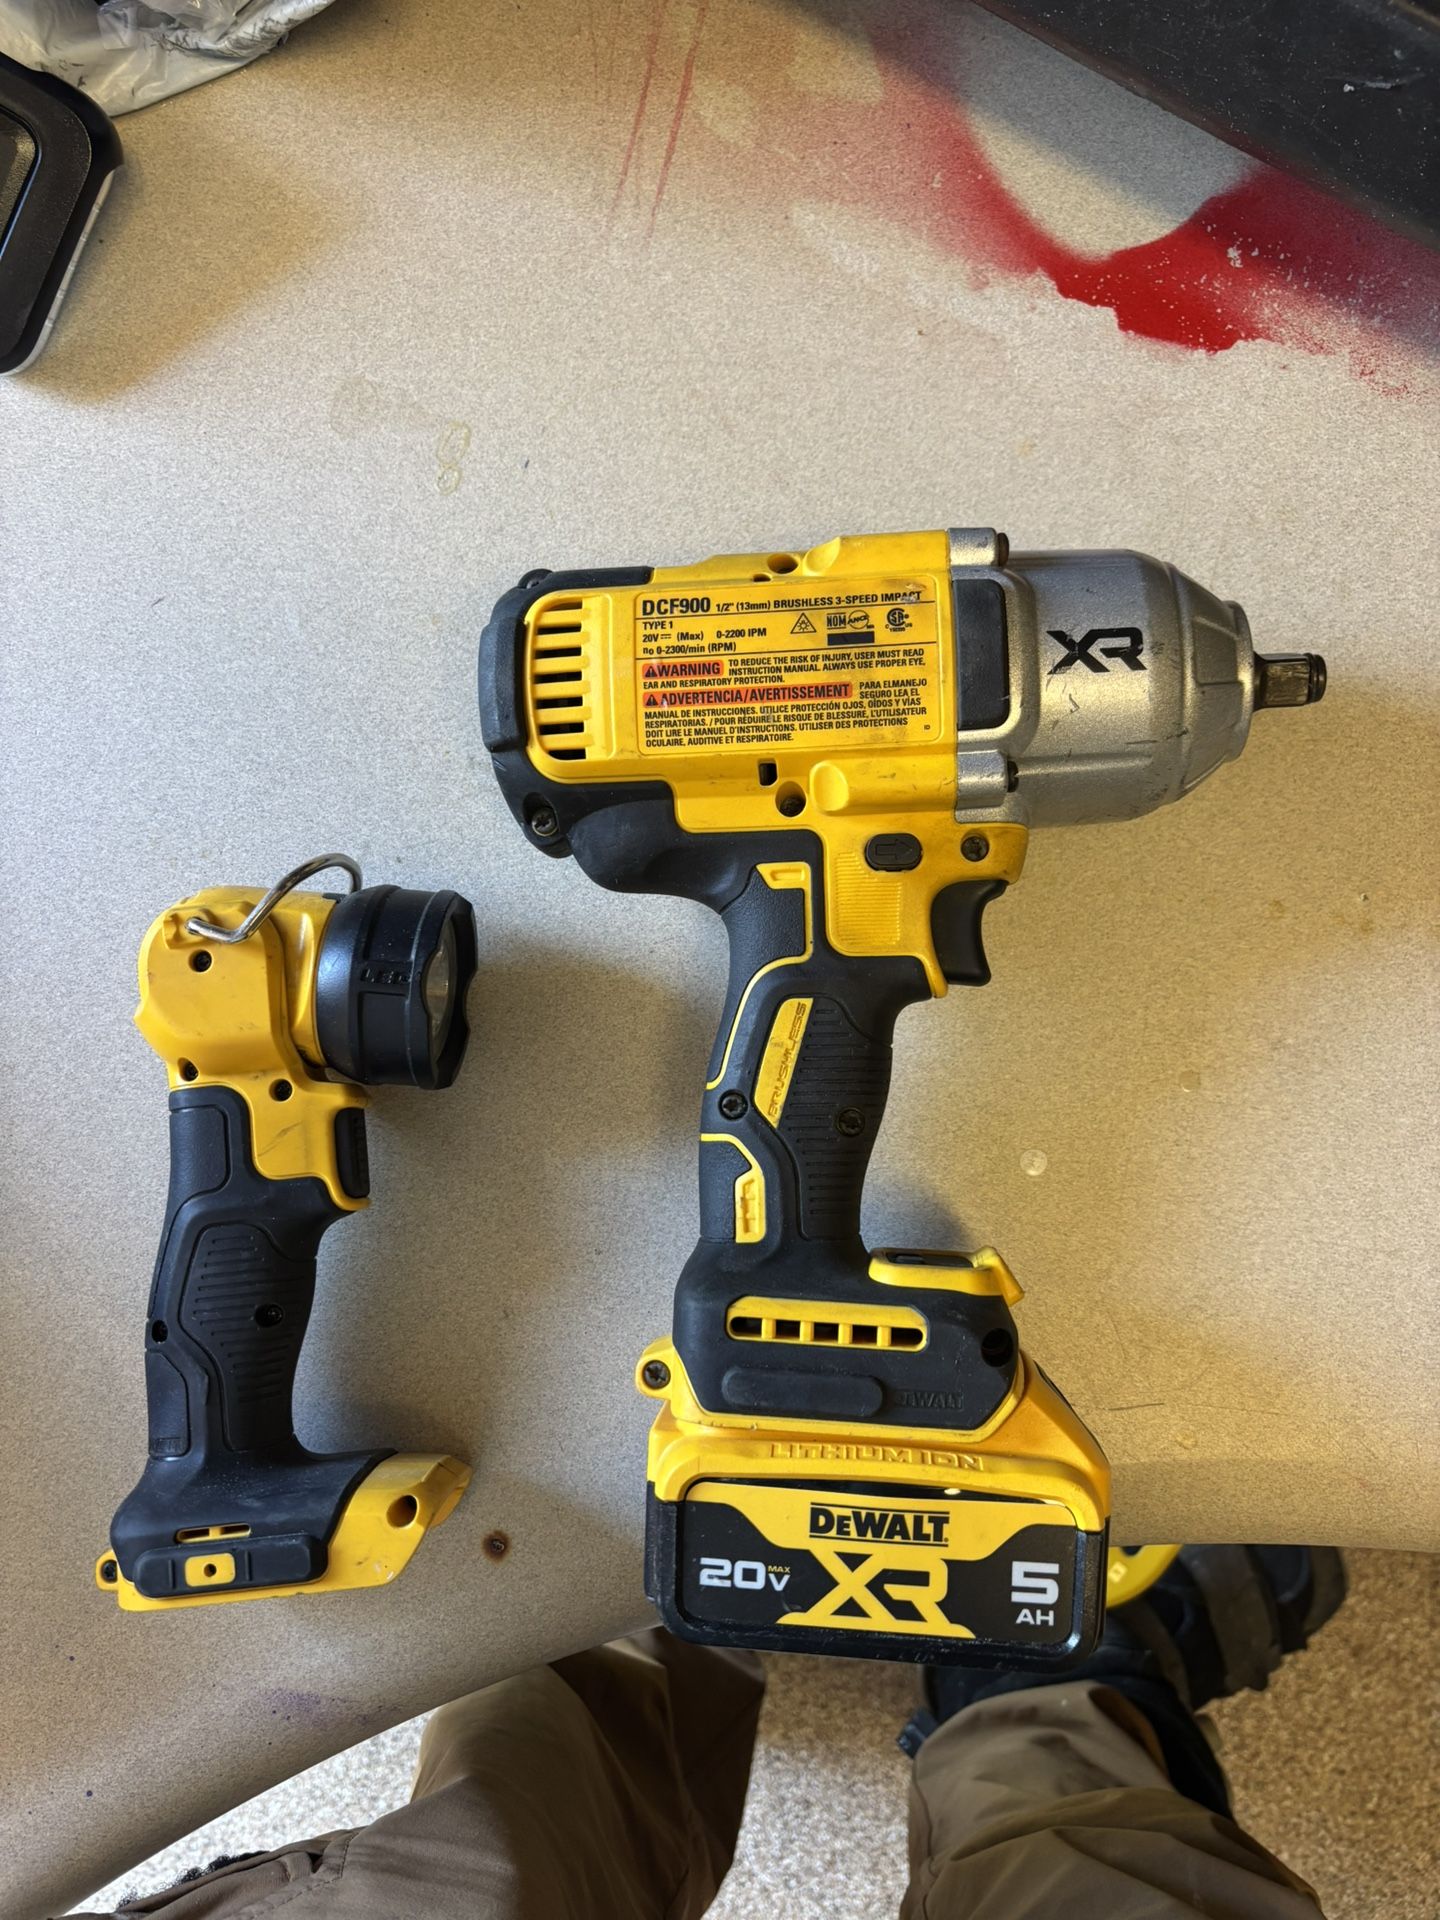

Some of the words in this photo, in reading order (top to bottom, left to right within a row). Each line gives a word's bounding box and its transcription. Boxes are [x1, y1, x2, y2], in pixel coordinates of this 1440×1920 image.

[642, 597, 711, 616] DCF900
[716, 603, 734, 613] 1/2"
[736, 600, 771, 611] (13mm)
[773, 597, 833, 609] BRUSHLESS
[835, 593, 878, 605] 3-SPEED
[881, 590, 922, 603] IMPACT
[642, 621, 666, 630] TYPE
[668, 620, 673, 629] 1
[826, 614, 846, 627] NOM
[642, 634, 659, 643] 20V
[677, 631, 704, 641] (Max)
[716, 629, 746, 639] 0-2200
[748, 628, 767, 637] IPM
[656, 644, 705, 655] 0-2300/min
[708, 641, 736, 653] (RPM)
[1046, 627, 1148, 675] XR
[728, 659, 739, 667] TO
[740, 658, 771, 666] REDUCE
[773, 656, 788, 664] THE
[790, 655, 808, 664] RISK
[810, 654, 820, 662] OF
[822, 652, 853, 662] INJURY,
[854, 651, 875, 660] USER
[877, 650, 901, 659] MUST
[903, 648, 924, 657] READ
[657, 662, 721, 677] WARNING
[728, 665, 782, 676] INSTRUCTION
[823, 661, 856, 671] ALWAYS
[857, 659, 873, 669] USE
[876, 658, 907, 668] PROPER
[643, 681, 658, 689] EAR
[660, 680, 677, 688] AND
[679, 677, 733, 688] RESPIRATORY
[734, 675, 785, 685] PROTECTION.
[859, 681, 881, 690] PARA
[859, 689, 892, 699] SEGURO
[894, 688, 908, 697] LEA
[910, 687, 919, 696] EL
[645, 710, 679, 719] MANUAL
[681, 709, 691, 717] DE
[693, 706, 758, 717] INSTRUCCIONES.
[760, 704, 789, 714] UTILICE
[790, 700, 841, 712] PROTECCIÓN
[894, 699, 900, 707] Y
[902, 696, 921, 706] VÍAS
[645, 718, 708, 729] RESPIRATORIAS.
[715, 717, 736, 725] POUR
[737, 713, 771, 724] RÉDUIRE
[772, 714, 781, 723] LE
[783, 713, 812, 722] RISQUE
[814, 712, 824, 721] DE
[826, 710, 869, 720] BLESSURE,
[870, 707, 927, 718] L'UTILISATEUR
[646, 730, 664, 738] DOIT
[665, 728, 682, 737] LIRE
[684, 728, 692, 737] LE
[694, 726, 727, 736] MANUEL
[799, 721, 834, 731] UTILISER
[835, 720, 851, 729] DES
[853, 717, 908, 728] PROTECTIONS
[646, 738, 686, 747] OCULAIRE,
[688, 736, 723, 746] AUDITIVE
[725, 735, 733, 744] ET
[736, 733, 793, 743] RESPIRATOIRE.
[771, 1443, 912, 1464] LITHIUM
[921, 1450, 984, 1471] ION
[768, 1565, 791, 1574] MAX
[785, 1547, 968, 1636] XR
[1010, 1560, 1060, 1606] 5
[1016, 1608, 1055, 1627] AH
